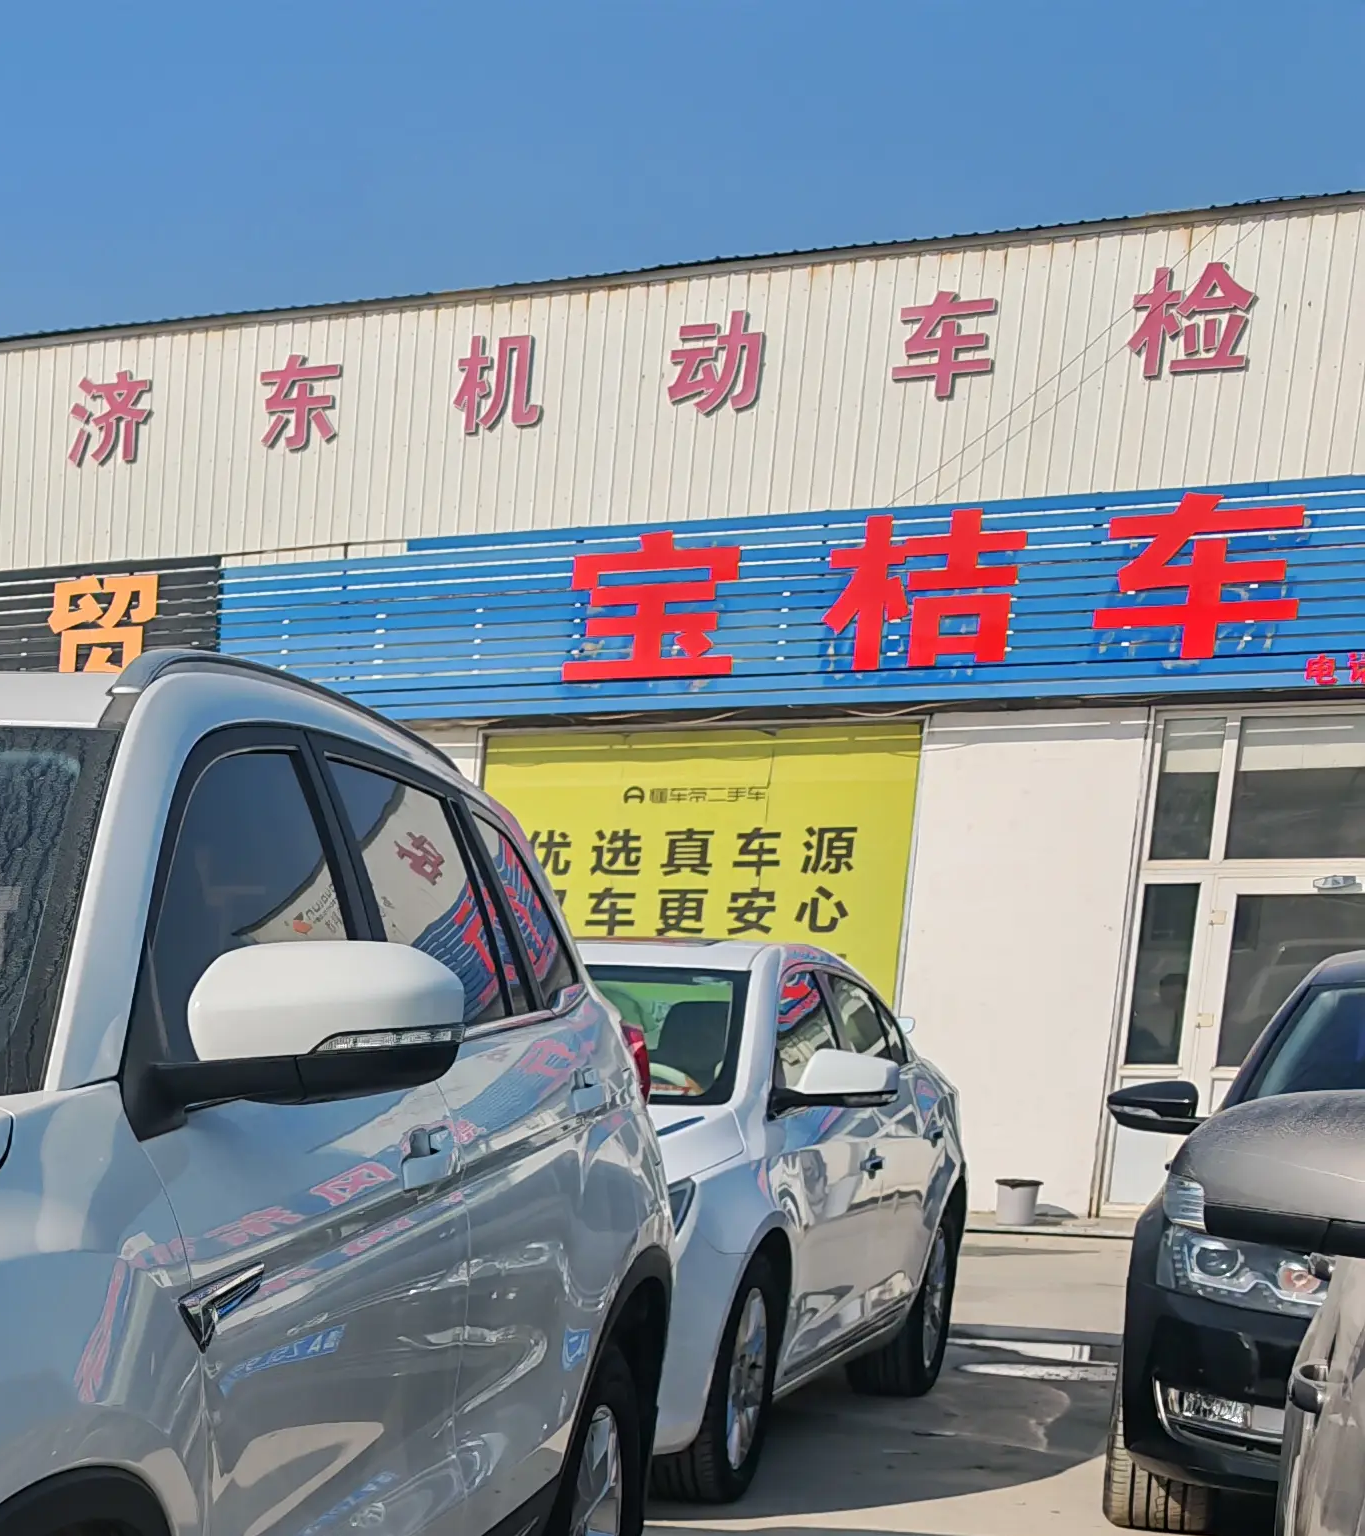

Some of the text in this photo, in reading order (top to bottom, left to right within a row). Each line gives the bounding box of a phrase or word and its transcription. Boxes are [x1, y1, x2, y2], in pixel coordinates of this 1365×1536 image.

[561, 492, 1308, 683] 宝桔车
[528, 825, 859, 878] 优选真车源
[556, 885, 849, 938] 车更安心
